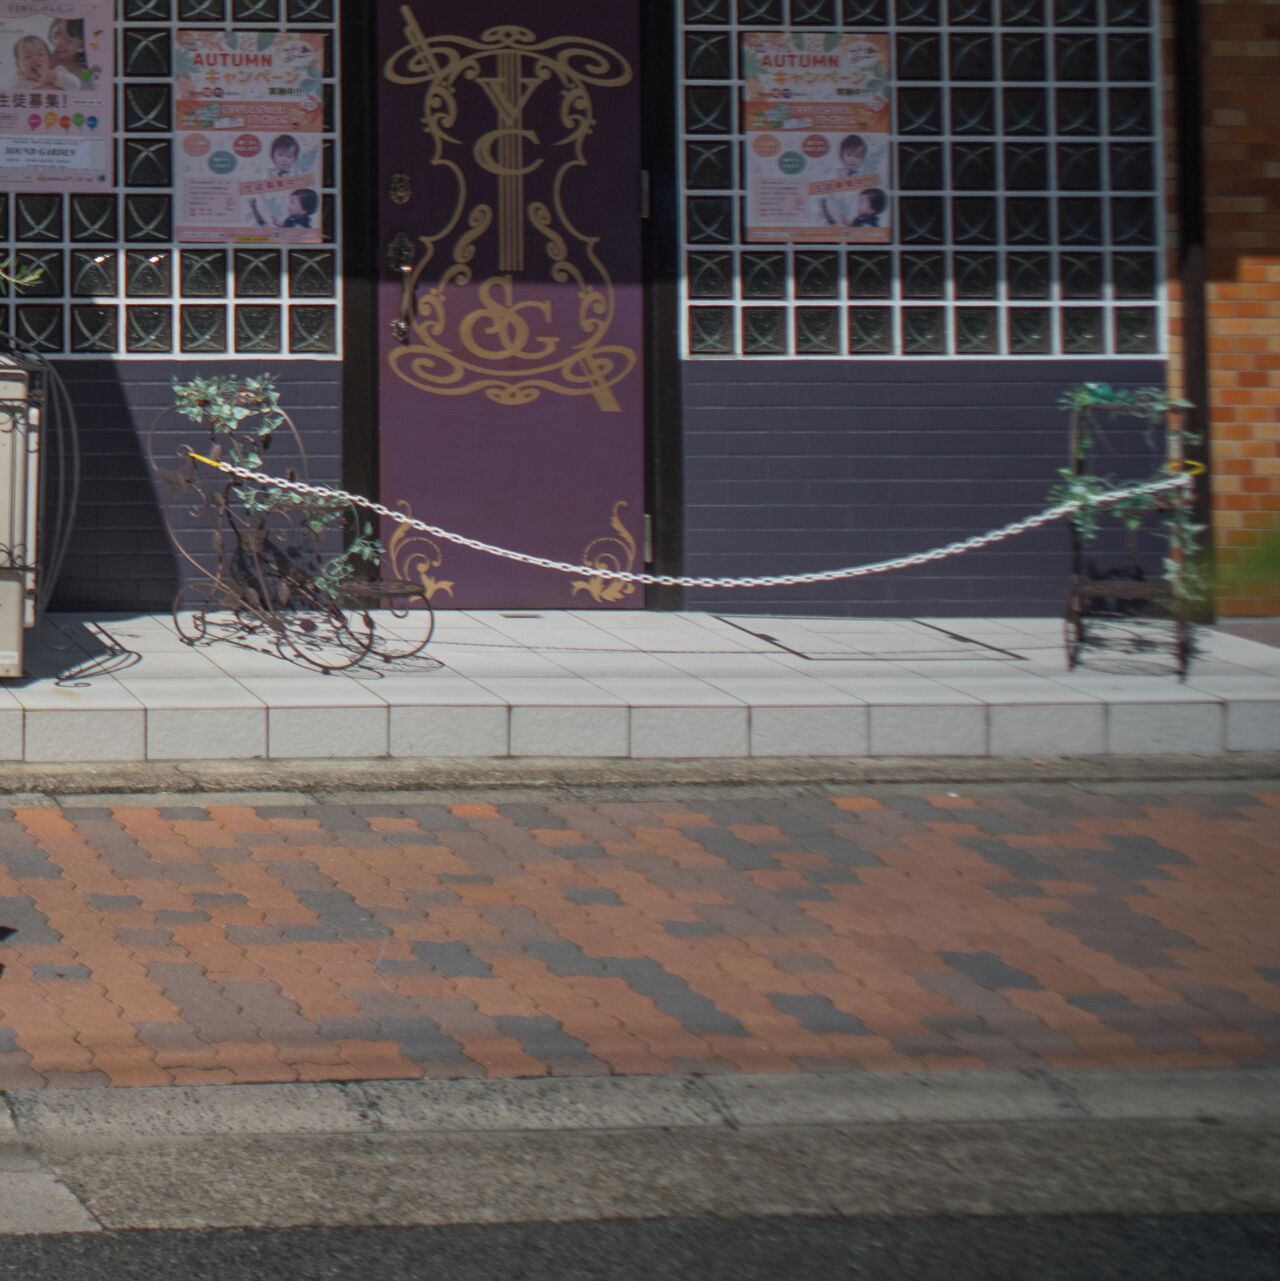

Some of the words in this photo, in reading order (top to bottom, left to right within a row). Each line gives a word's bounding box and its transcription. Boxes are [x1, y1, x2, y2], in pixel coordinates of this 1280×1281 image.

[192, 53, 273, 67] AUTUMN
[761, 54, 840, 68] AUTUMN
[203, 70, 300, 84] キャンペーン
[771, 71, 866, 85] キャンペーン
